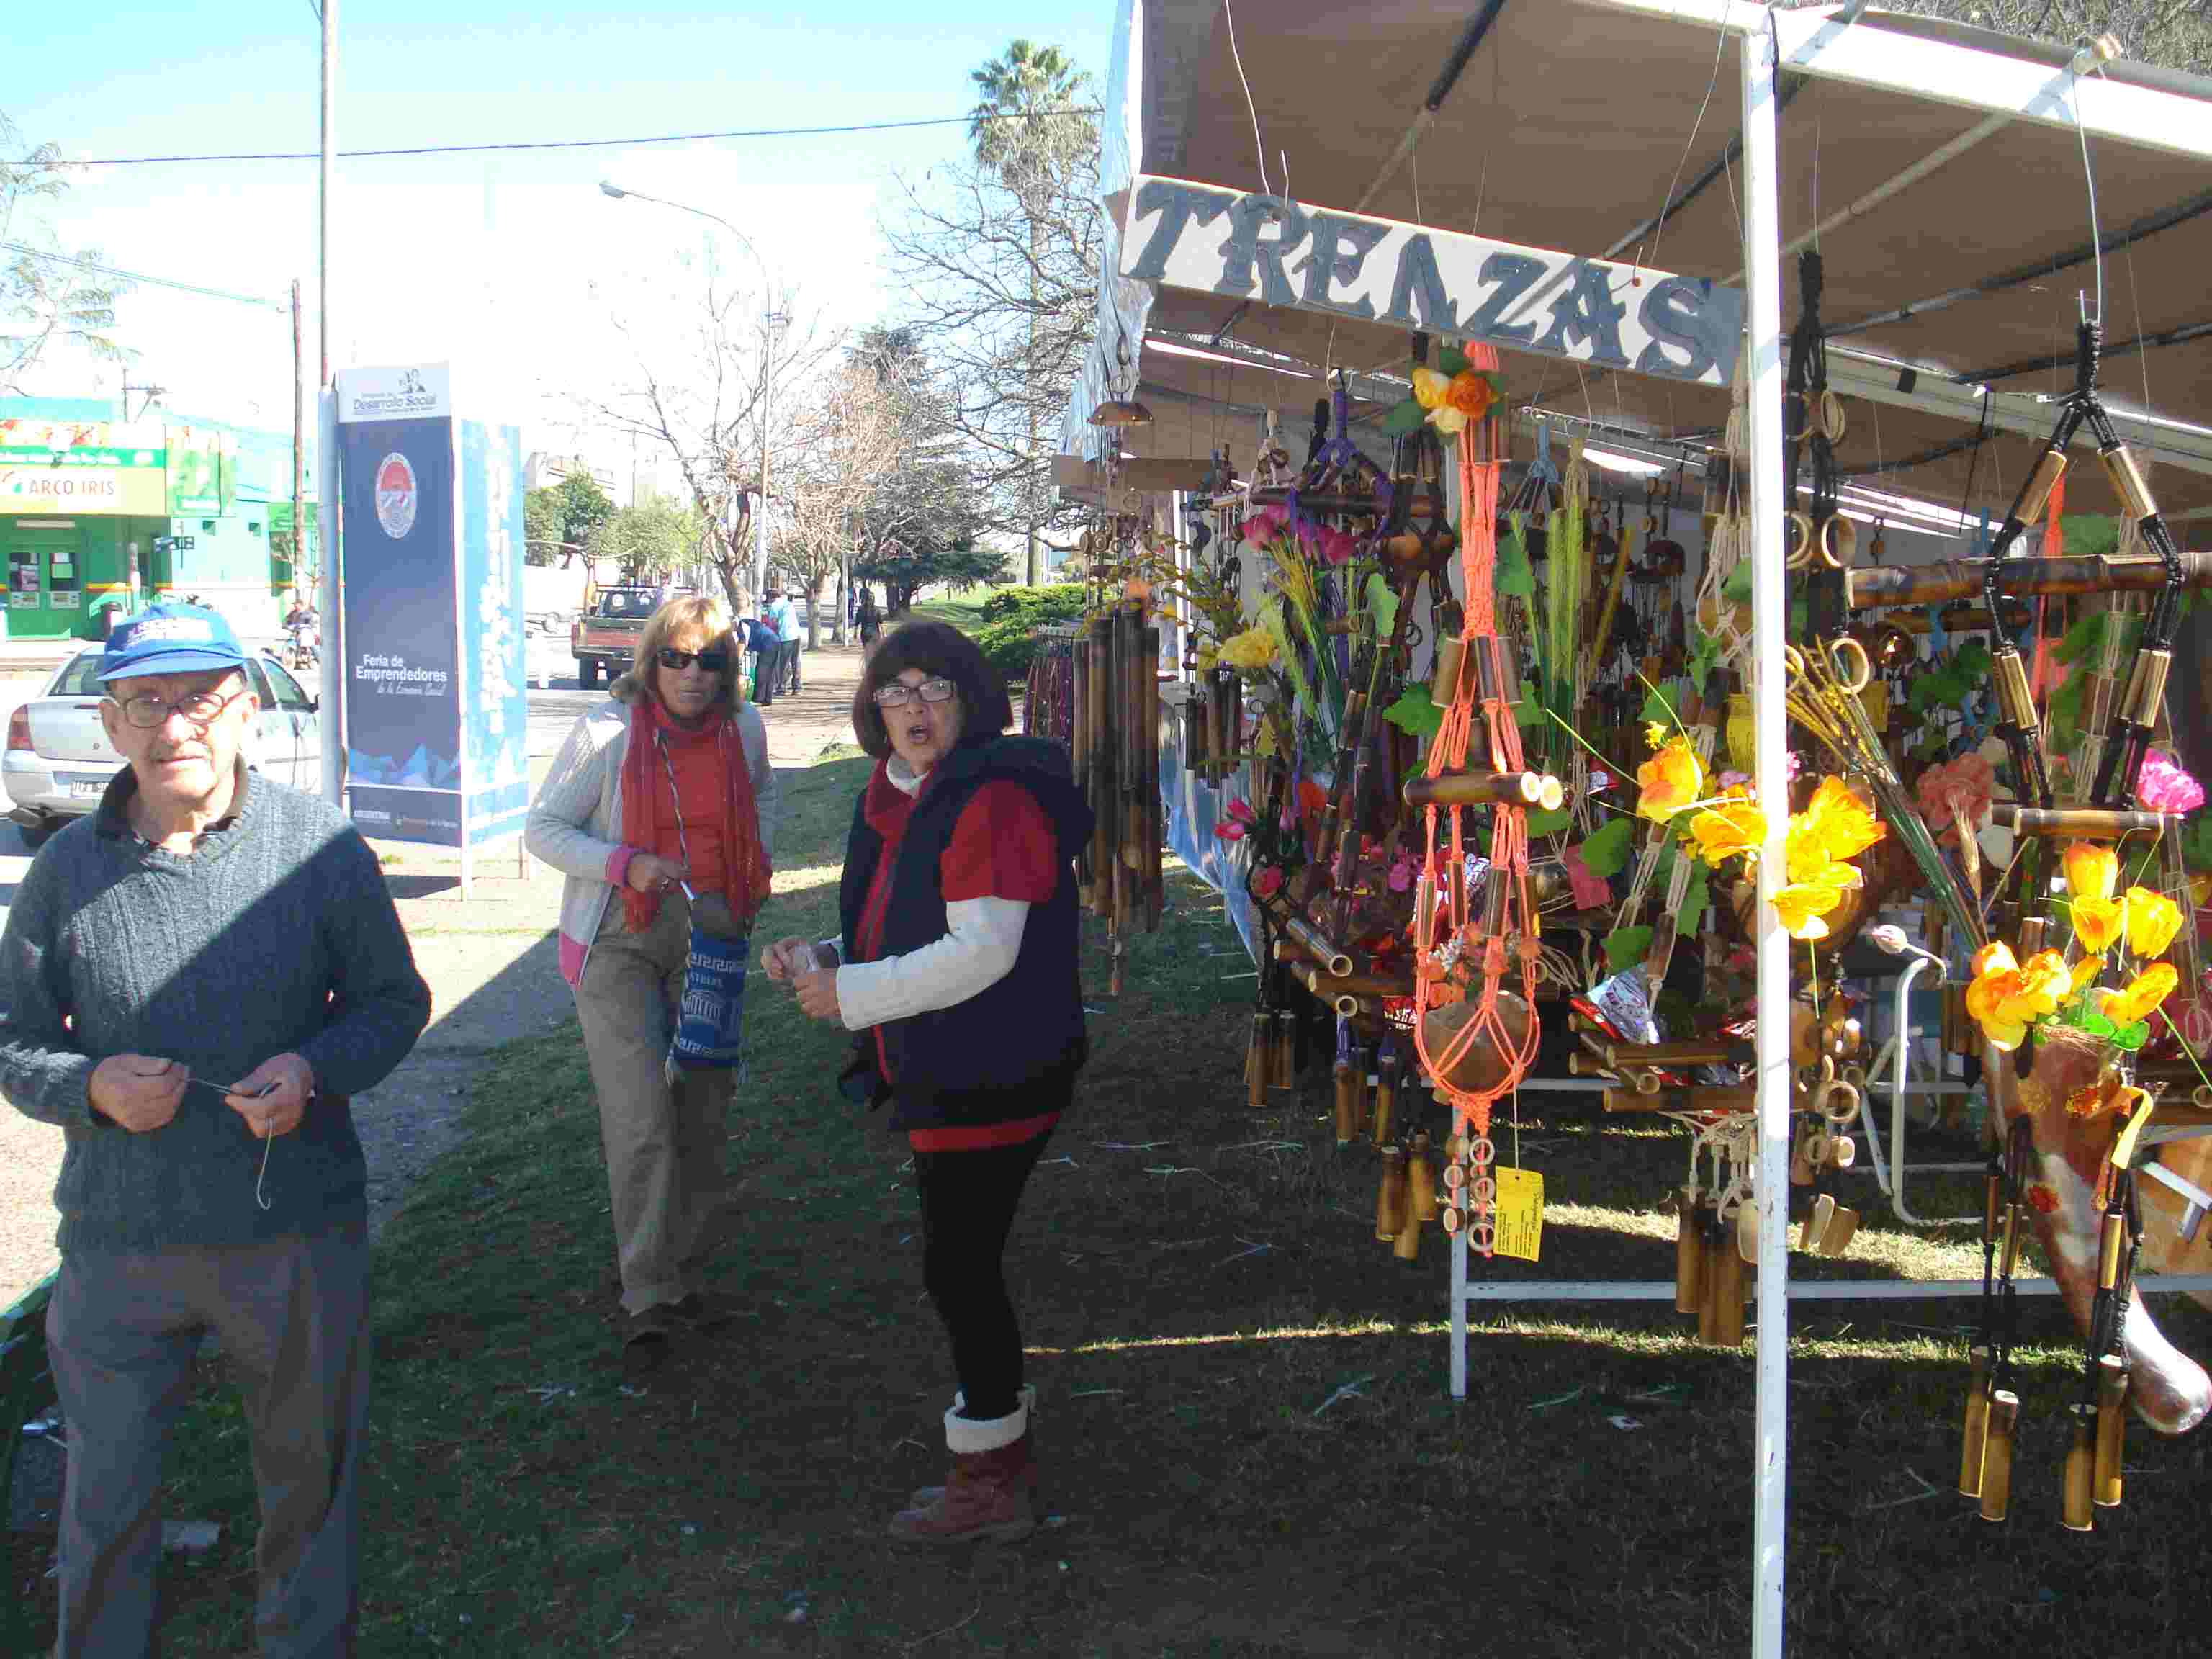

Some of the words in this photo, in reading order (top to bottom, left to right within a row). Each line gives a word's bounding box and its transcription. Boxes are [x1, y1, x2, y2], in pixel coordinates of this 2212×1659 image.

[29, 478, 74, 496] ARCO
[81, 478, 115, 496] IRIS
[362, 653, 389, 667] Feria
[391, 654, 404, 667] de
[356, 665, 448, 682] Emprendedores
